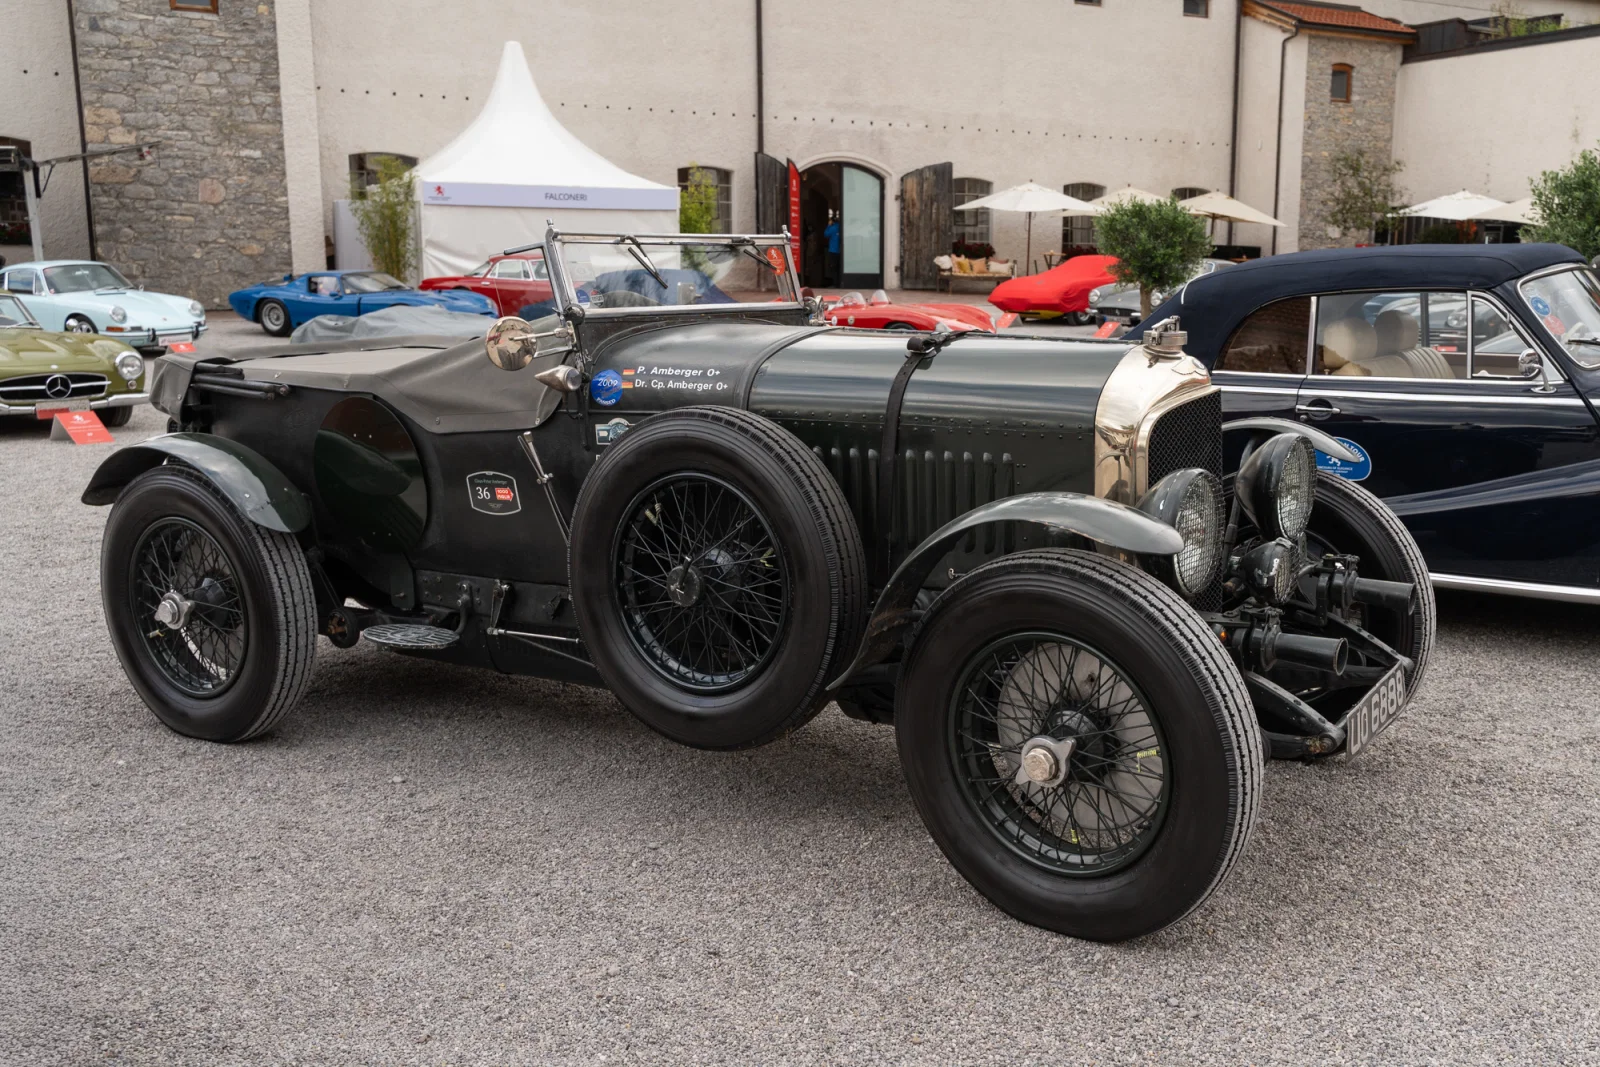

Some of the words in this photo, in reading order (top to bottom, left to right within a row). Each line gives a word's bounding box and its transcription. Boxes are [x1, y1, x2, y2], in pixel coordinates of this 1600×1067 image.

[544, 192, 588, 201] FALCONERI
[637, 366, 646, 374] P.
[650, 367, 703, 377] Amberger
[597, 379, 619, 387] 2009
[635, 379, 647, 388] Dr.
[667, 380, 714, 391] Amberger
[476, 486, 490, 500] 36
[1350, 706, 1369, 755] UO
[1371, 669, 1404, 733] 6888
